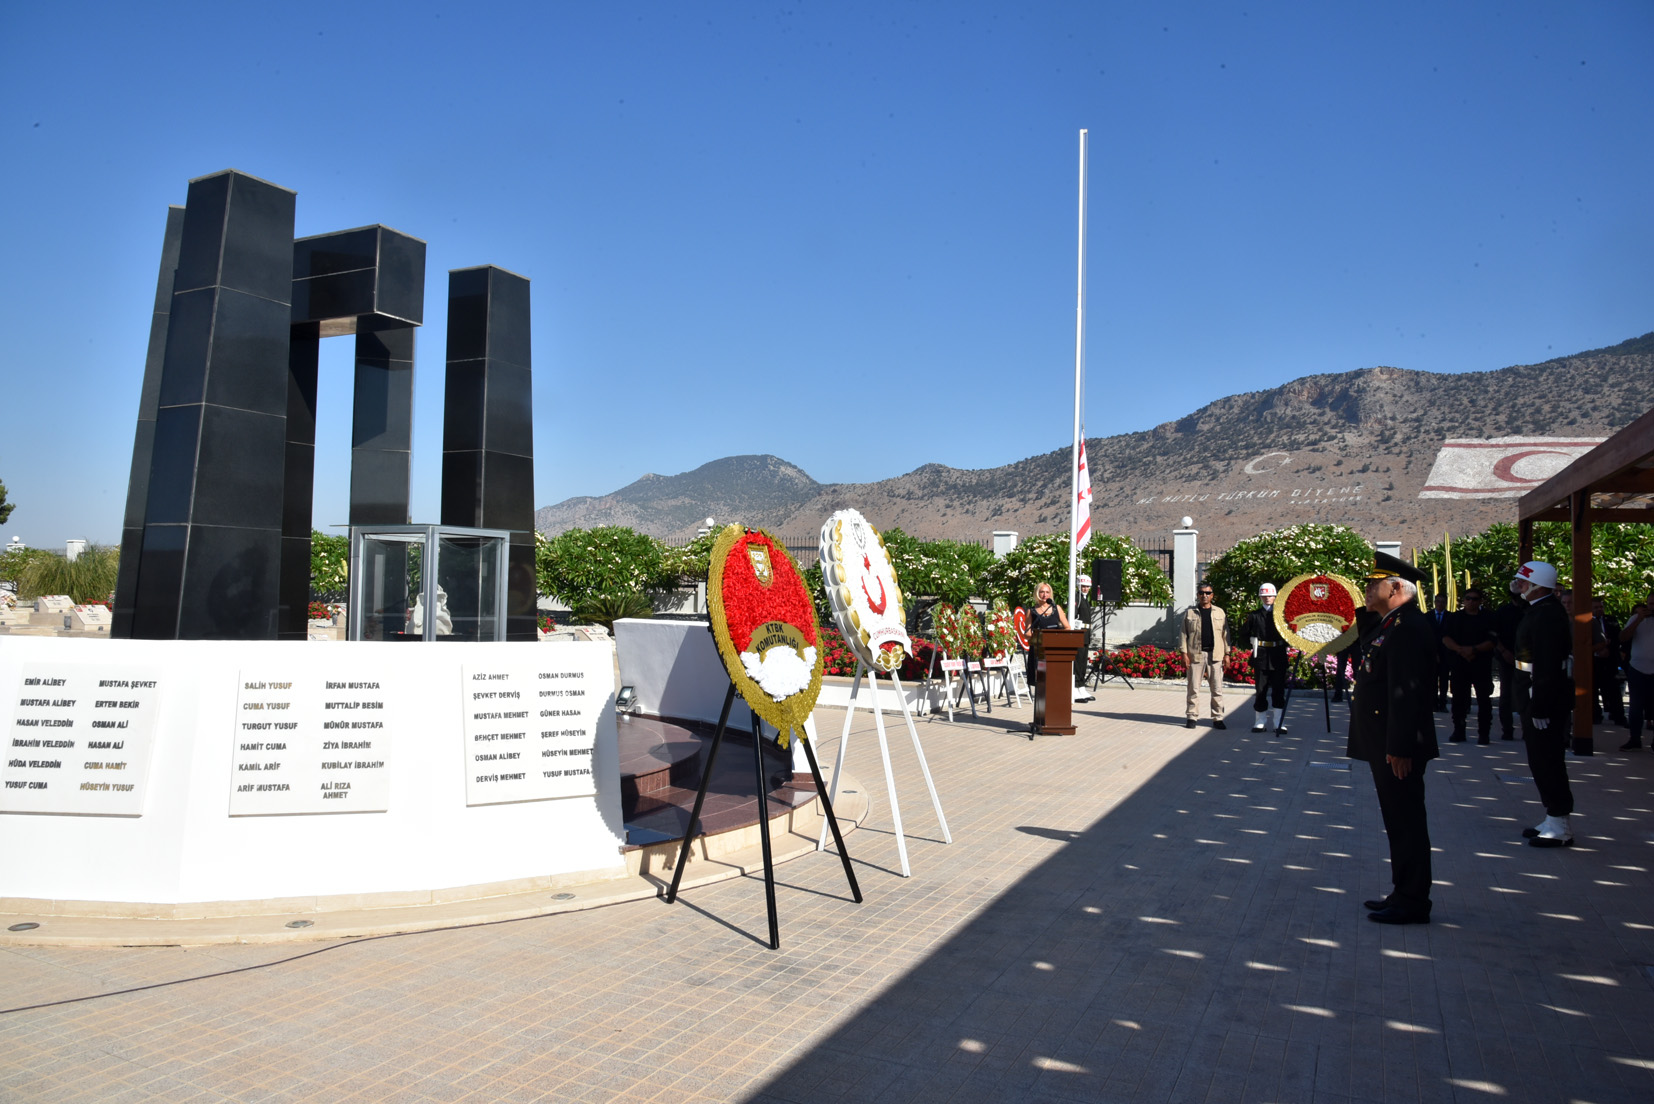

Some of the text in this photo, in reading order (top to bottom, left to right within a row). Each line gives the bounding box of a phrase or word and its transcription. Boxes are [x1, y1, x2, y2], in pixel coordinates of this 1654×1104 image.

[1136, 496, 1157, 505] NE
[1161, 493, 1210, 503] MUTLU
[765, 623, 784, 634] KTBK
[755, 634, 799, 654] KOMUTANLIĞI
[24, 677, 67, 686] EMİR ALİBEY
[99, 680, 157, 690] MUSTAFA ŞEVKET
[244, 681, 266, 690] SALİH
[326, 681, 346, 689] İRFAN
[473, 690, 520, 701] ŞEVKET DERVİŞ
[20, 698, 77, 707] MUSTAFA ALİBEY
[95, 700, 140, 709] ERTEM BEKİR
[266, 702, 291, 710] YUSUF
[325, 701, 383, 709] MUTTALİP BESİM
[474, 711, 529, 720] MUSTAFA MEHMET
[540, 709, 560, 717] GÜNER
[16, 718, 74, 728] HASAN VELEDDİN
[92, 720, 129, 729] OSMAN ALİ
[274, 722, 298, 730] YUSUF
[351, 721, 383, 729] MUSTAFA
[474, 732, 526, 742] BEHÇET MEHMET
[541, 728, 586, 739] ŞEREF HÜSEYİN
[12, 738, 75, 748] İBRAHİM VELEDDİN
[88, 740, 124, 749] HASAN ALİ
[240, 742, 264, 751] HAMİT
[323, 740, 371, 749] ZİYA İBRAHİM
[475, 752, 520, 762] OSMAN ALİBEY
[542, 749, 568, 757] HÜSEYİN
[28, 759, 62, 769] VELEDDİN
[84, 761, 127, 770] CUMA HAMİT
[238, 761, 281, 771] KAMİL ARİF
[321, 760, 384, 769] KUBİLAY İBRAHİM
[476, 773, 526, 783] DERVİŞ MEHMET
[543, 770, 562, 778] YUSUF
[5, 781, 28, 789] YUSUF
[80, 781, 135, 792] HÜSEYİN YUSUF
[237, 783, 290, 792] ARİF MUSTAFA
[320, 781, 351, 792] ALİ RIZA
